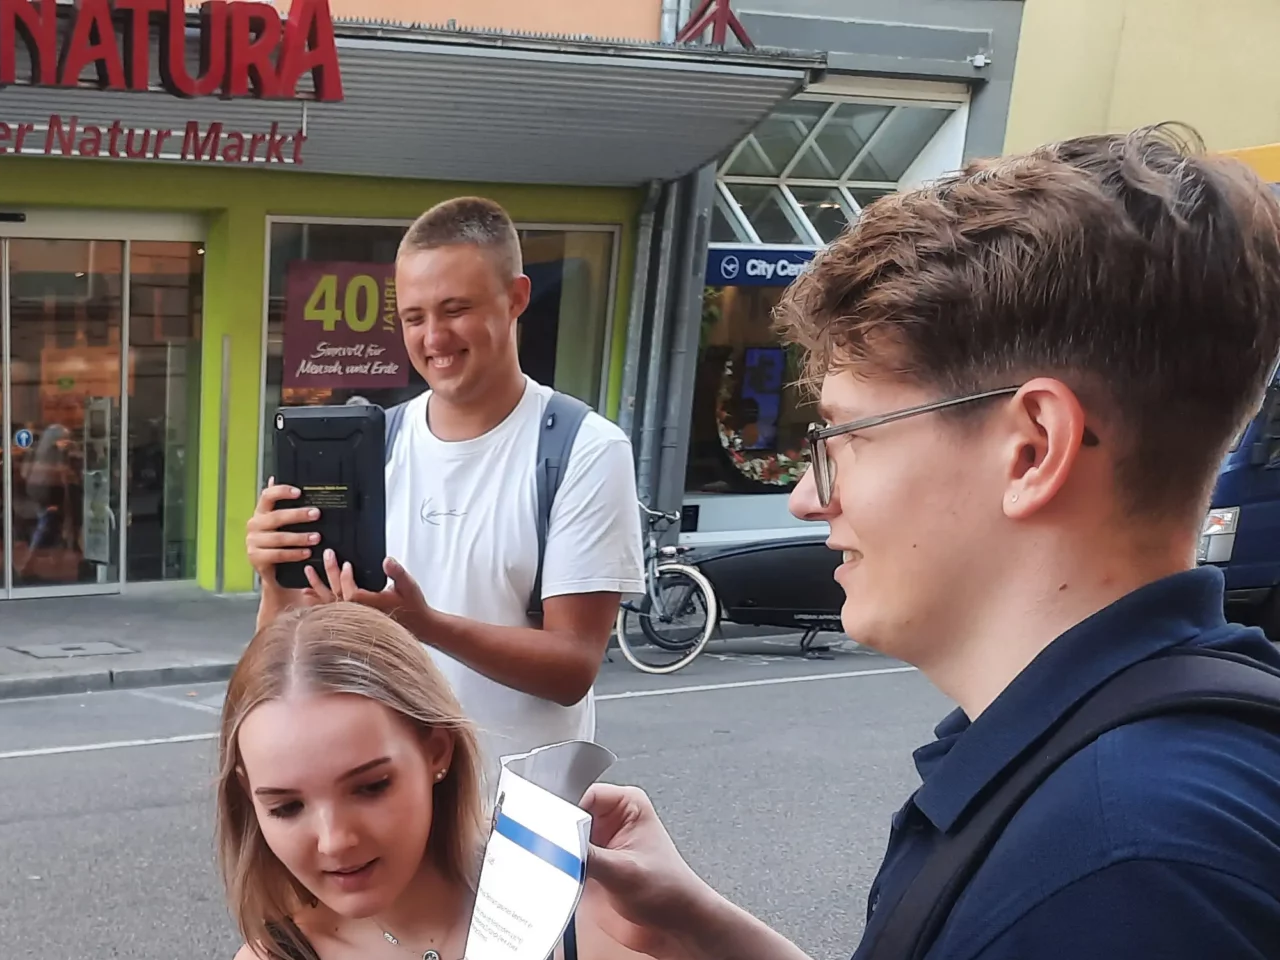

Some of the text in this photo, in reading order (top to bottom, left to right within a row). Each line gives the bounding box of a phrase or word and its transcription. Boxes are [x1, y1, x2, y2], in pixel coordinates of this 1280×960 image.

[45, 113, 171, 160] Natur
[180, 120, 307, 165] Markt
[746, 259, 776, 279] City
[303, 274, 379, 333] 40
[295, 359, 399, 377] Mensch und Erde
